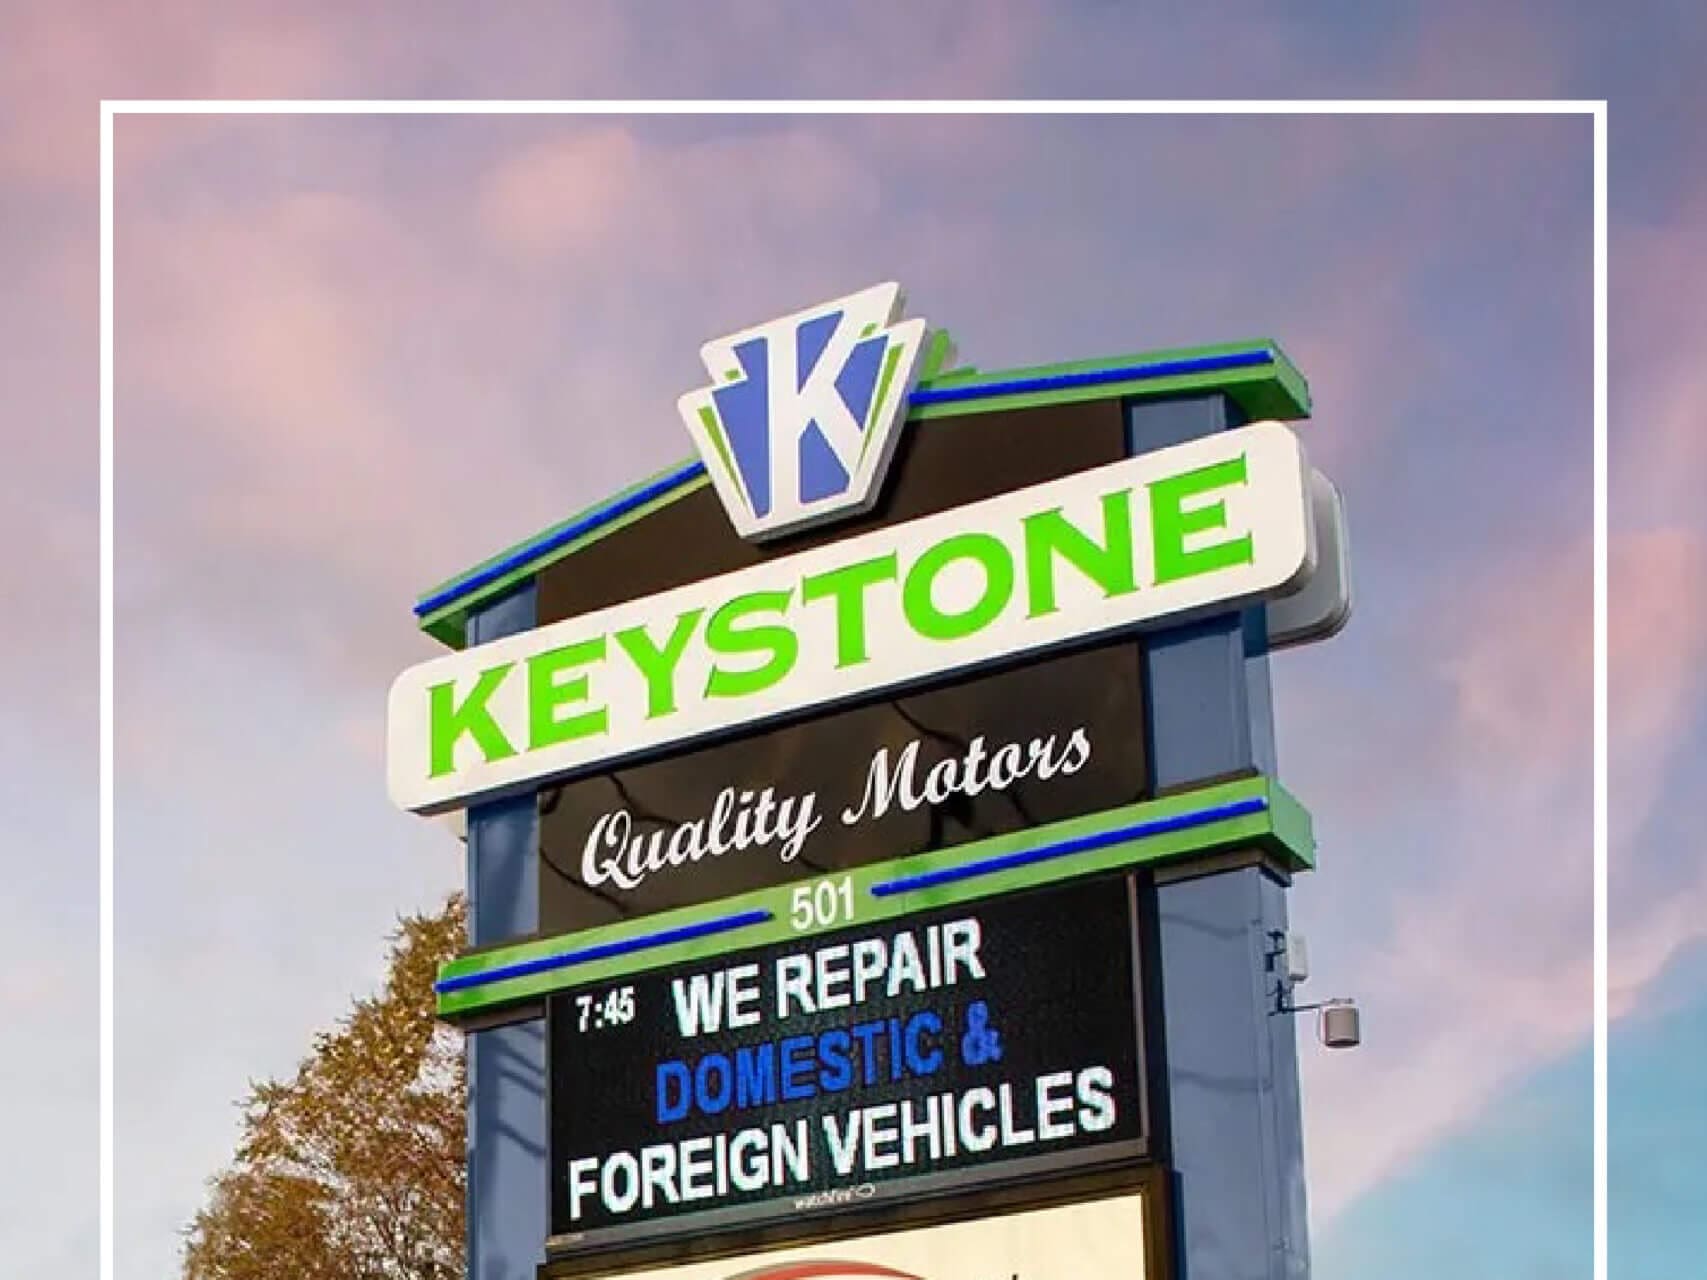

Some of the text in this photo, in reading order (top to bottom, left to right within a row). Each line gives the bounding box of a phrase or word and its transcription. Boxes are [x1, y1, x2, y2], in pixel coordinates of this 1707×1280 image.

[425, 453, 1254, 778] KEYSTONE
[581, 721, 1093, 889] Quality Motors
[790, 876, 856, 930] 501
[575, 986, 636, 1032] 7:45
[671, 917, 986, 1038] WE REPAIR
[655, 1000, 1002, 1125] DOMESTIC &
[568, 1065, 1117, 1220] FOREIGN VEHICLES
